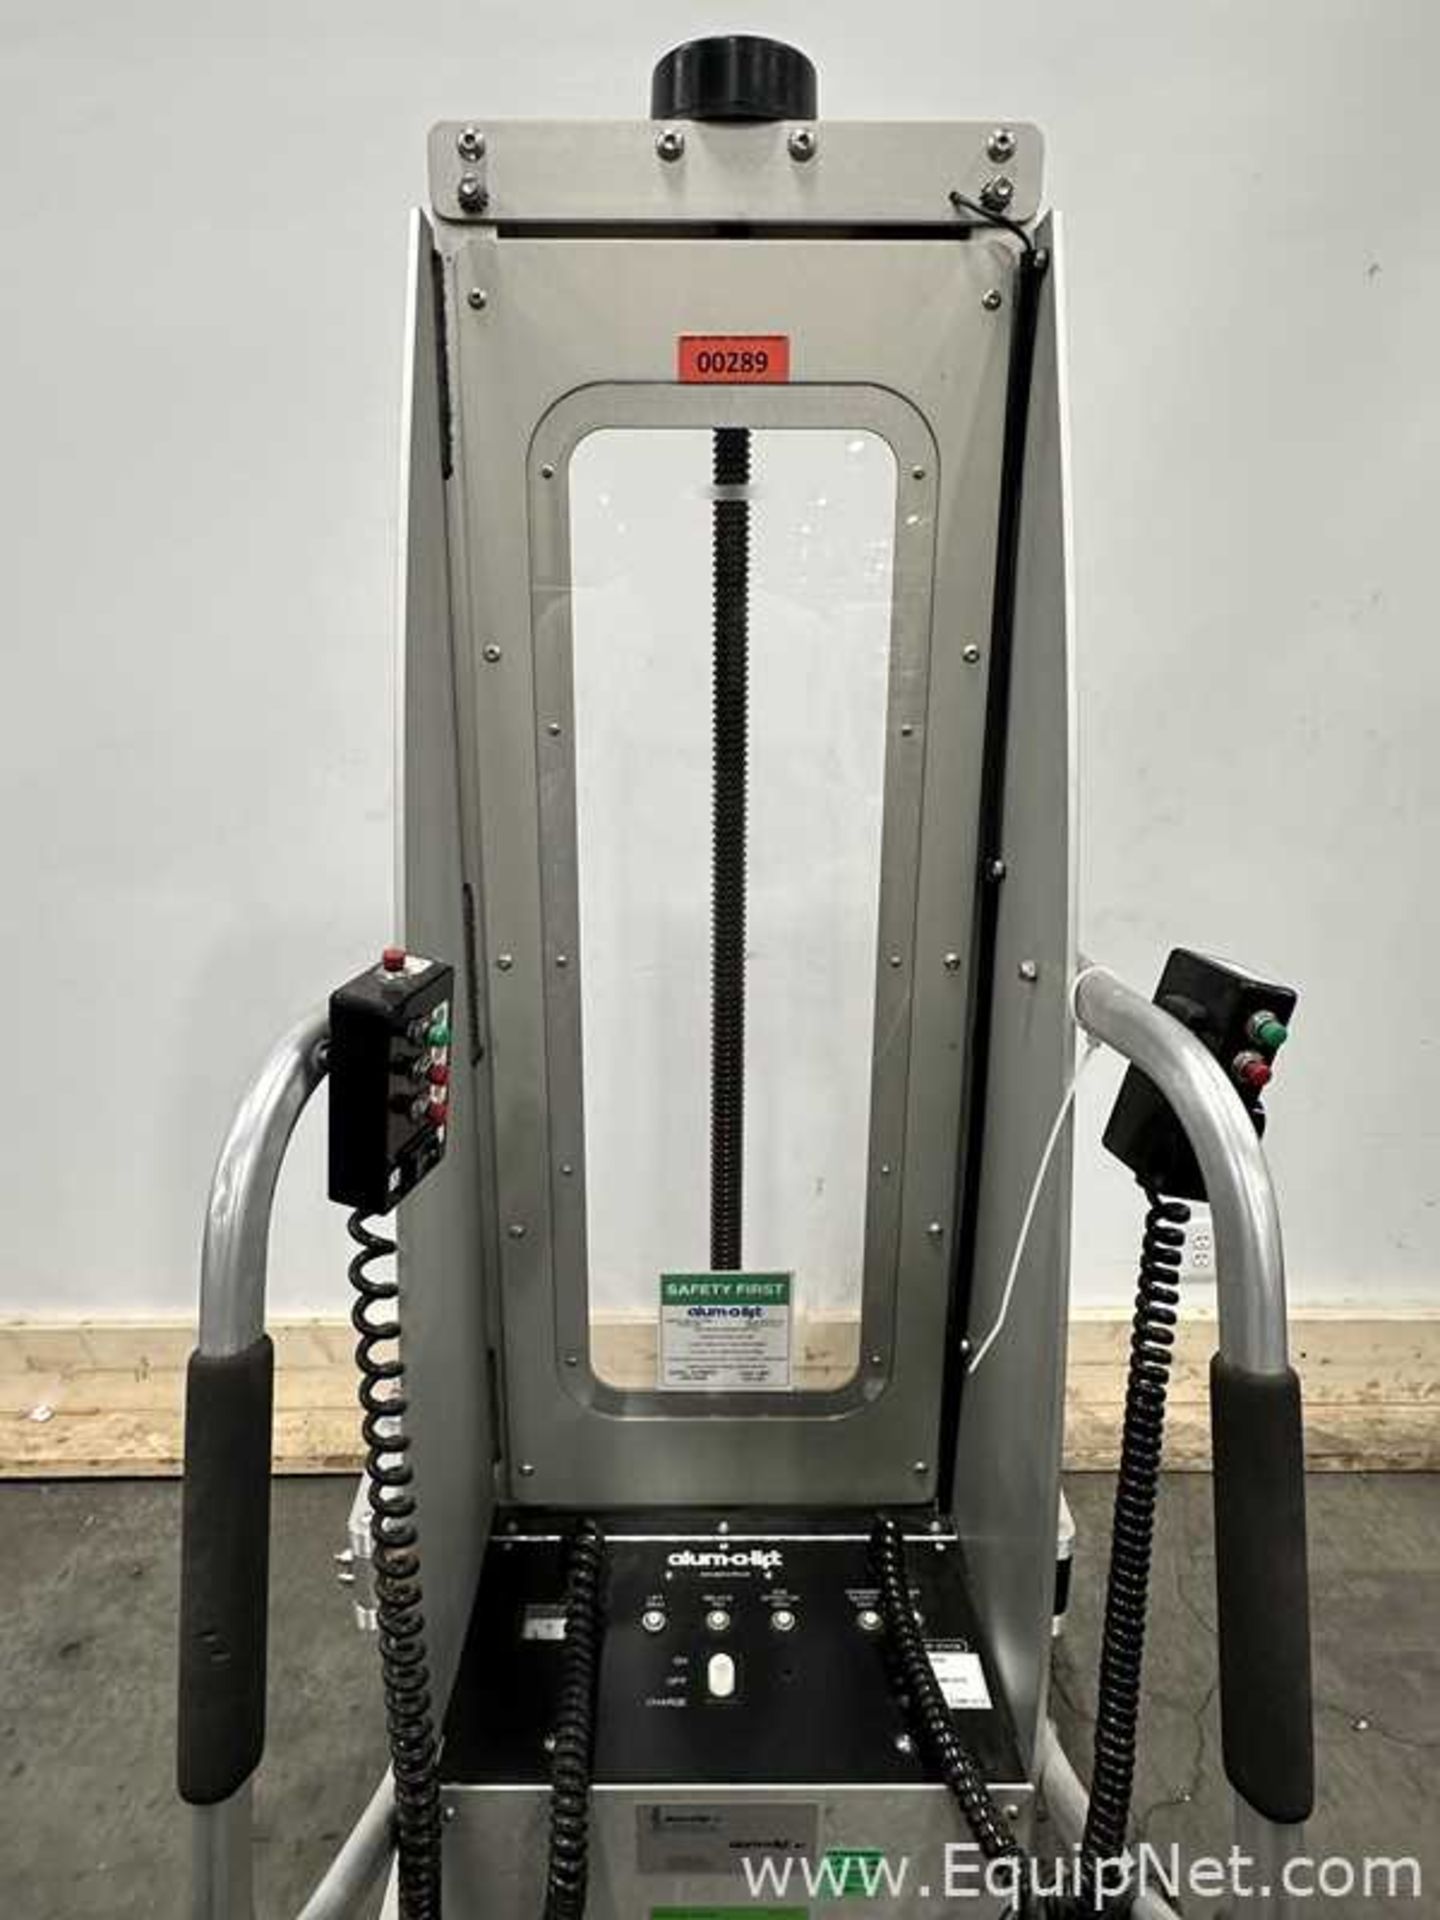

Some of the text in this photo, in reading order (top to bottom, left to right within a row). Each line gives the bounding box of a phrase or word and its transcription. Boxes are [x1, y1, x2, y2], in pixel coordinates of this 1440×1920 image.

[697, 351, 768, 373] 00289
[666, 1283, 783, 1296] SAFETY FIRST
